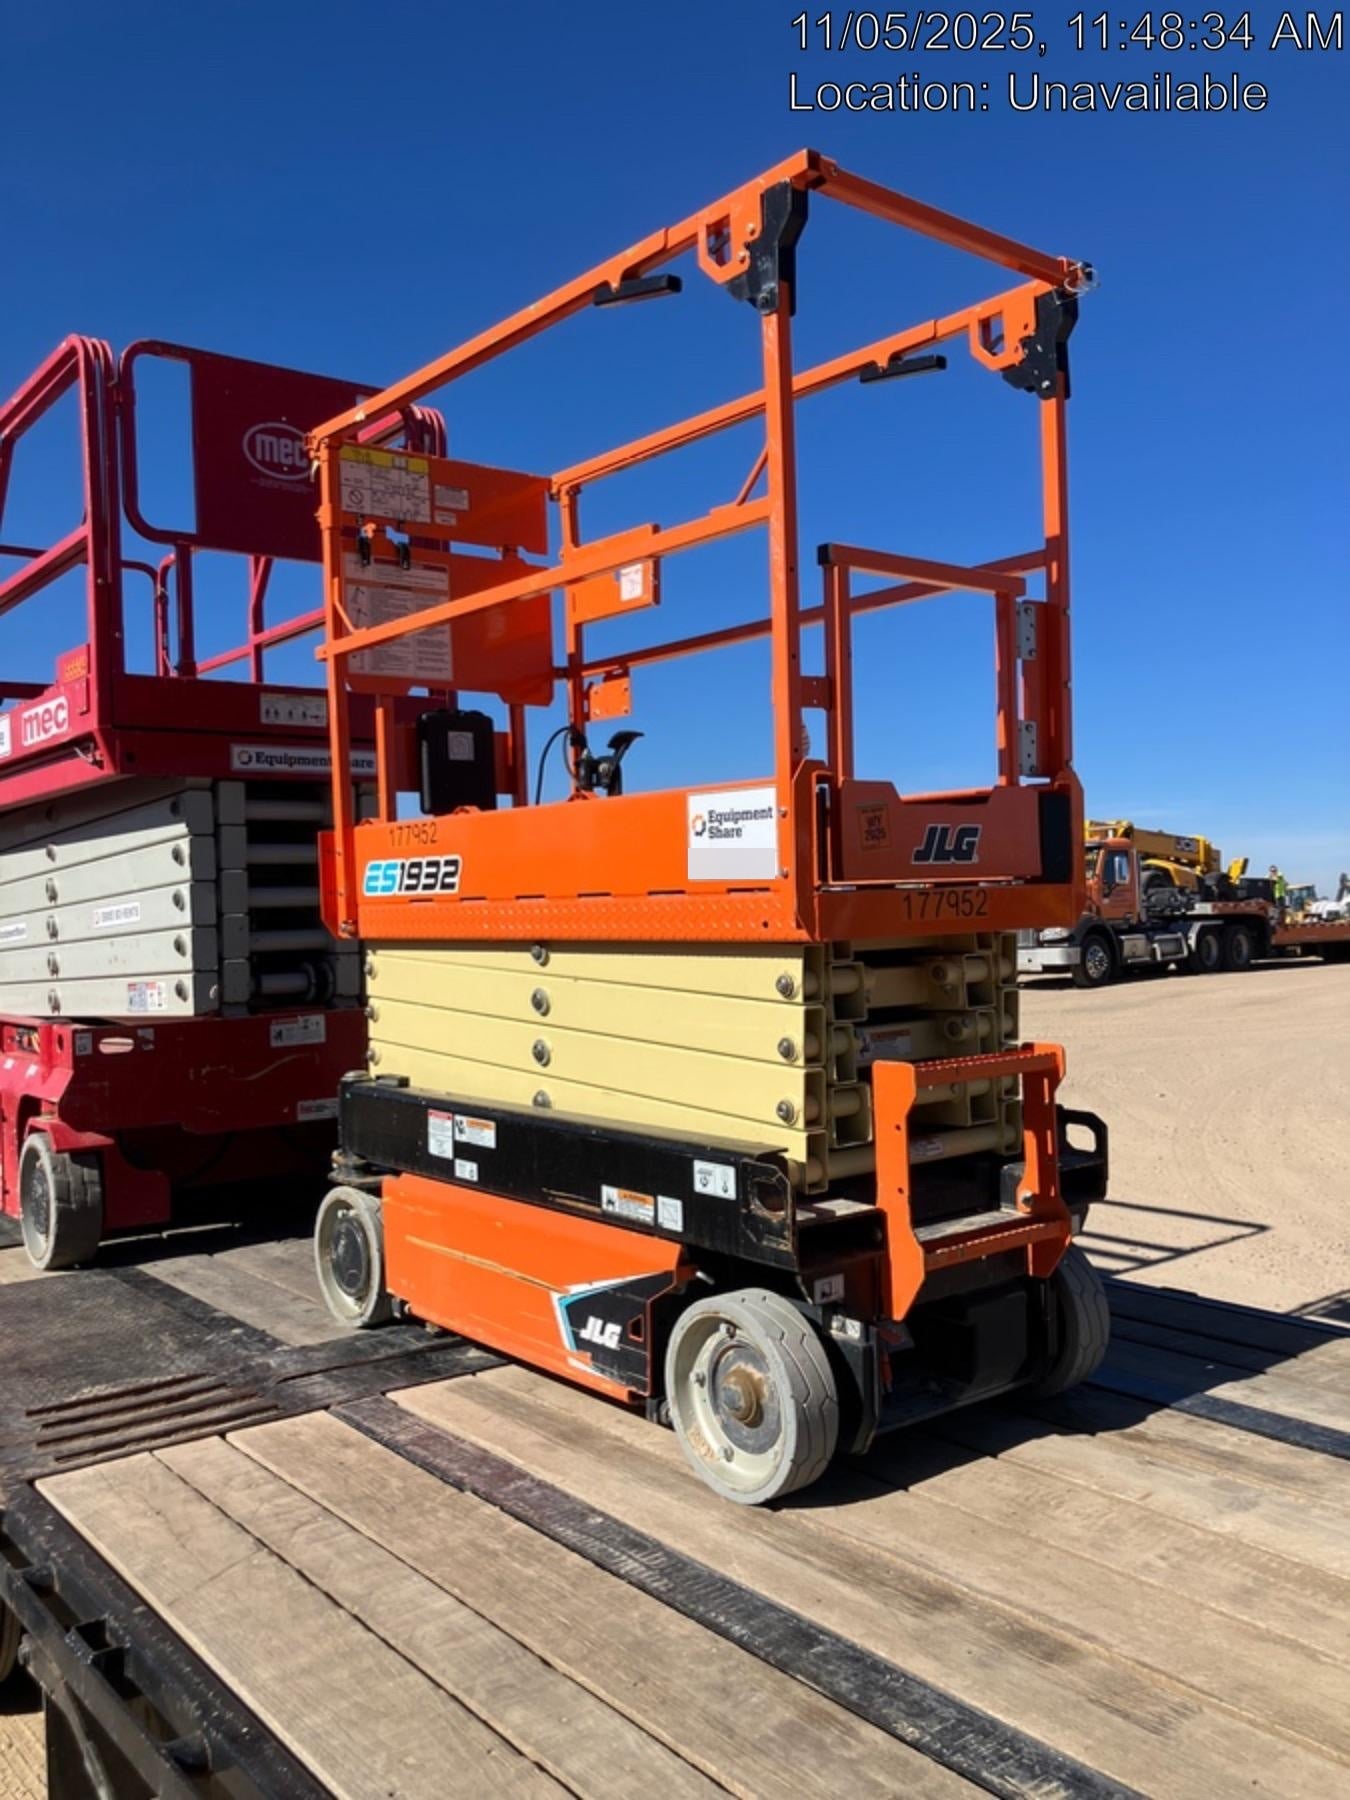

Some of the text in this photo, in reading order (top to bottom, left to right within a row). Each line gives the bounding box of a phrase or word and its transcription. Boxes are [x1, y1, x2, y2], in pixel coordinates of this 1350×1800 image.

[255, 433, 309, 469] mec
[23, 702, 67, 743] mec
[707, 805, 774, 826] Equipment
[707, 825, 743, 840] Share
[389, 821, 438, 847] 177952
[911, 823, 983, 865] JLG
[364, 857, 460, 894] ES1932
[903, 888, 989, 921] 177952
[579, 1315, 622, 1351] JLG
